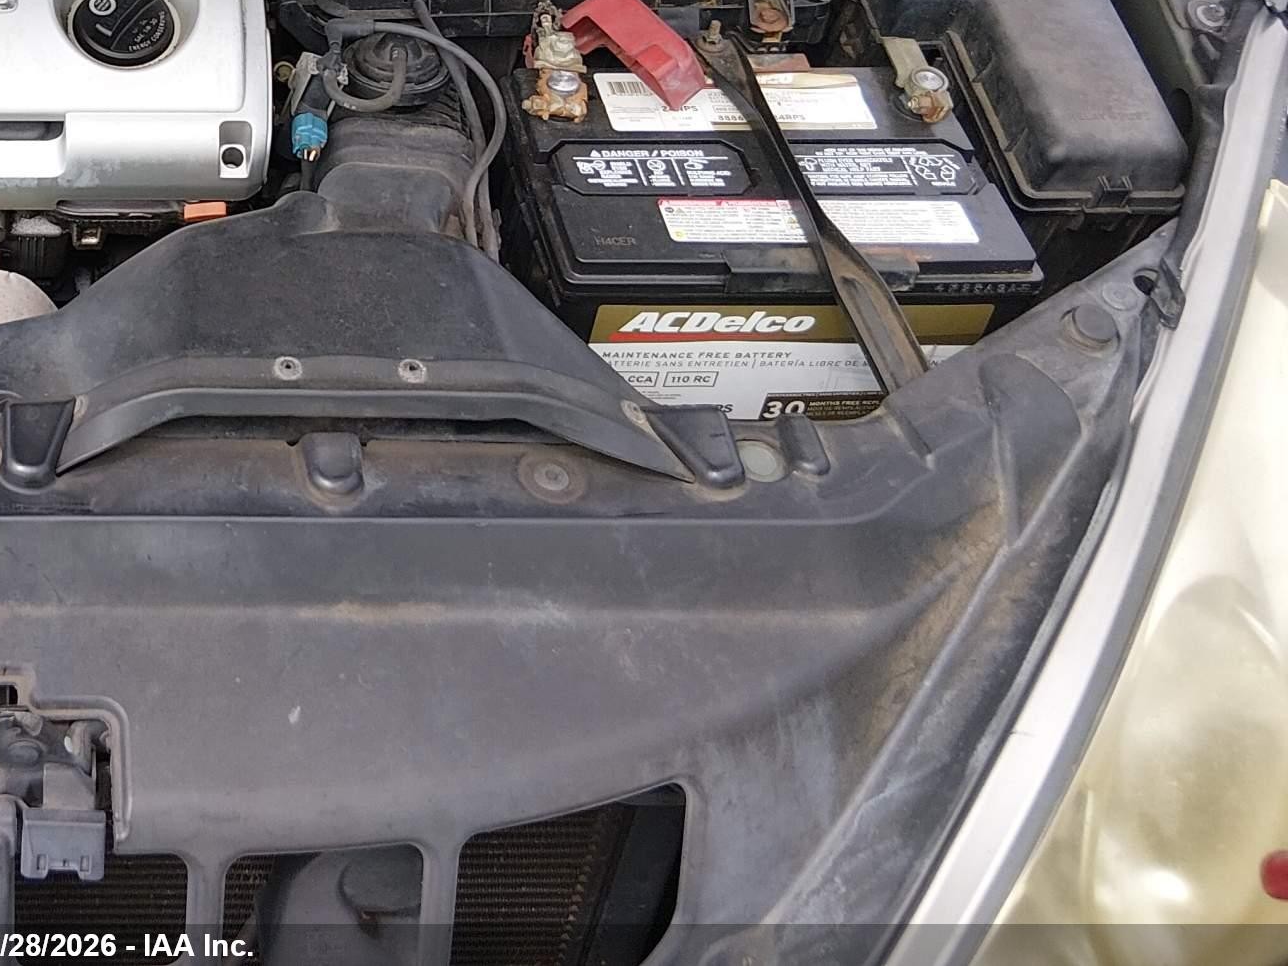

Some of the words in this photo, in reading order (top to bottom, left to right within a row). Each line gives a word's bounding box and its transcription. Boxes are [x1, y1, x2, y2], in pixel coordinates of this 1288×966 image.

[619, 311, 816, 333] ACDelco
[602, 351, 693, 359] MAINTENANCE
[697, 351, 730, 359] FREE
[734, 351, 792, 359] BATTERY
[655, 360, 683, 368] SANS
[759, 359, 805, 367] BATERÍA
[627, 375, 653, 383] CCA
[763, 400, 806, 418] 30
